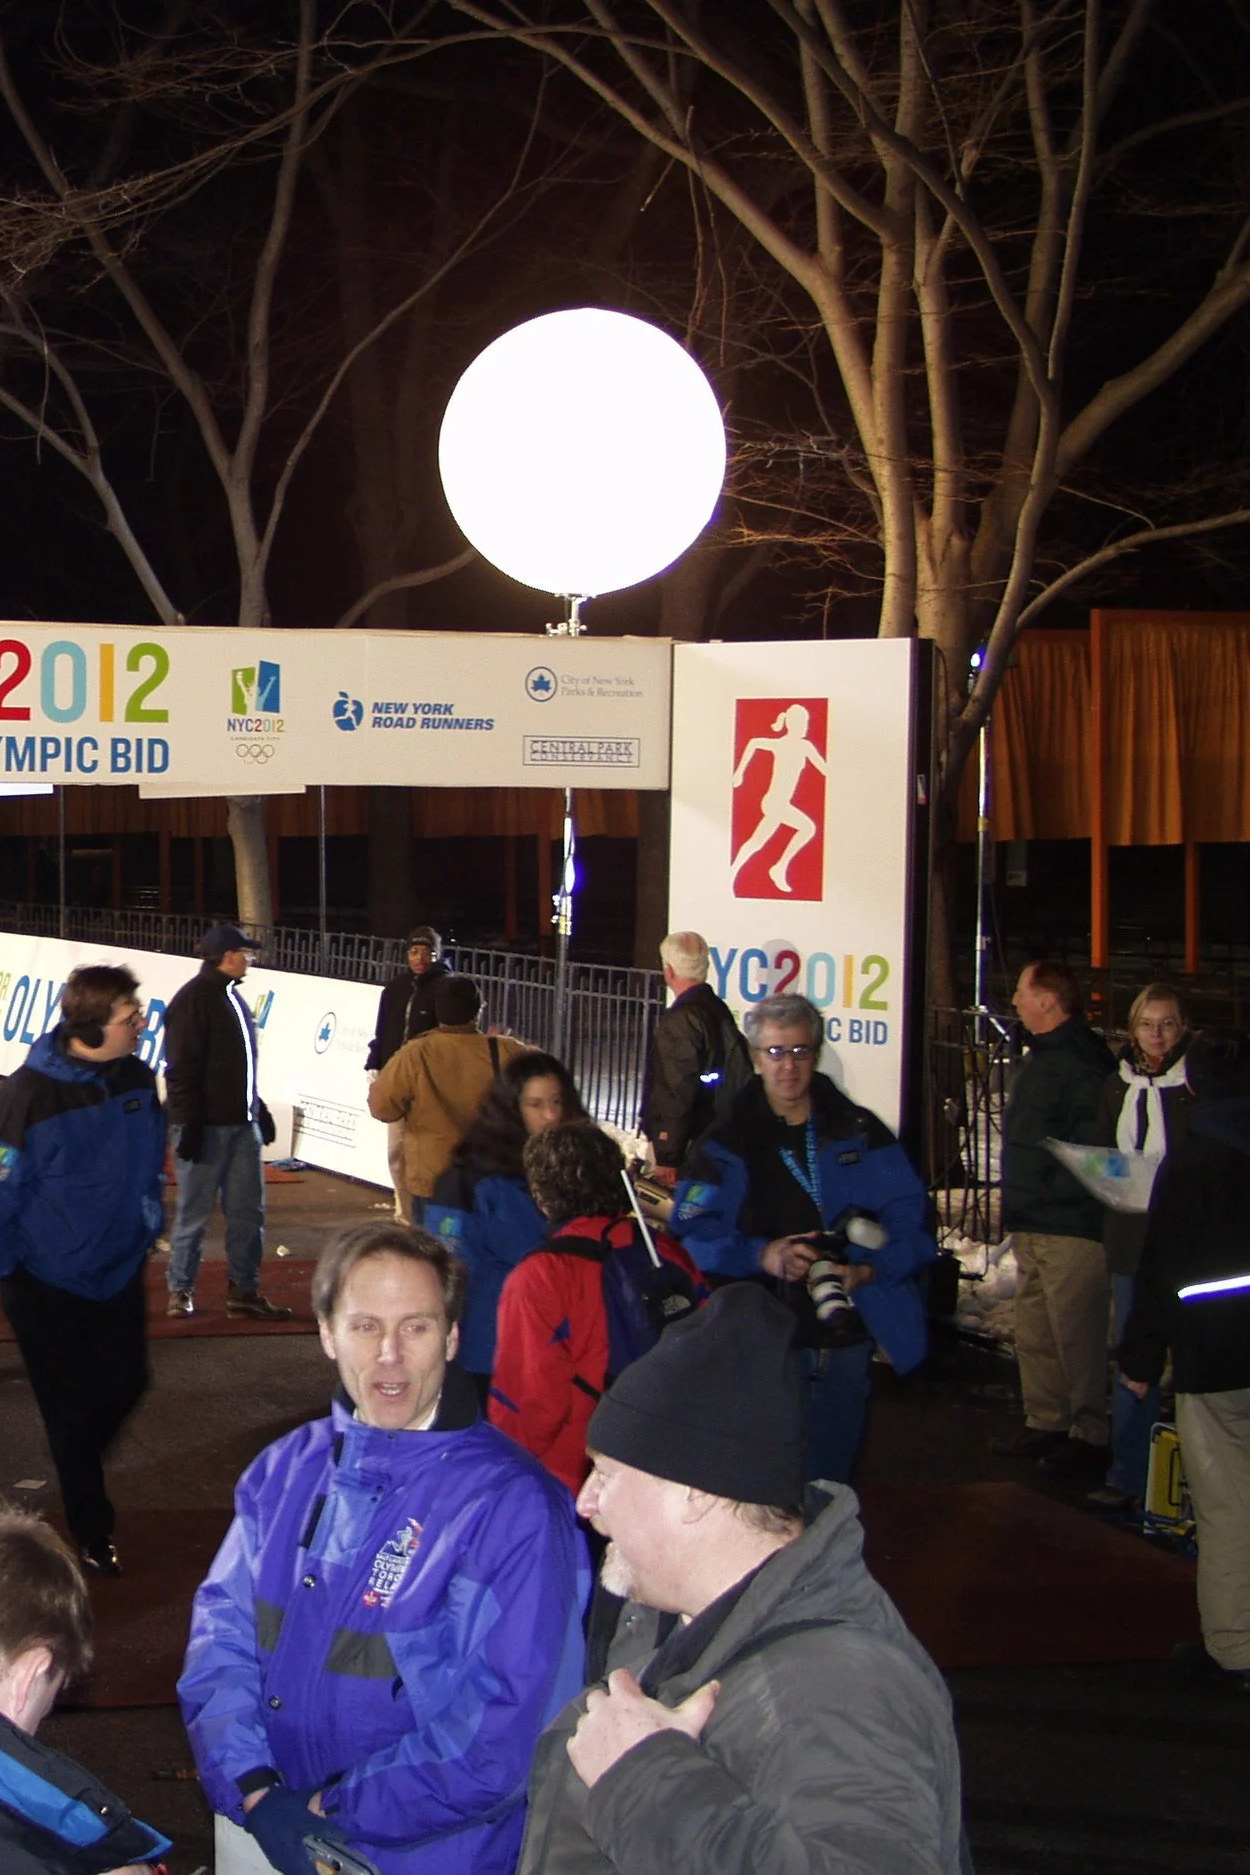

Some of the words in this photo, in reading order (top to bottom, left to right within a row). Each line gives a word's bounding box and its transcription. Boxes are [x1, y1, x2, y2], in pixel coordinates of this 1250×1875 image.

[372, 702, 408, 714] NEW
[413, 703, 454, 716] YORK
[227, 718, 285, 733] NYC2012
[371, 716, 416, 729] ROAD
[420, 717, 495, 731] RUNNERS
[110, 737, 170, 774] BID
[530, 740, 593, 754] CENTRAL
[598, 742, 633, 755] PARK
[709, 946, 890, 1011] YC2012
[2, 974, 65, 1046] OLY
[848, 1019, 889, 1046] BID
